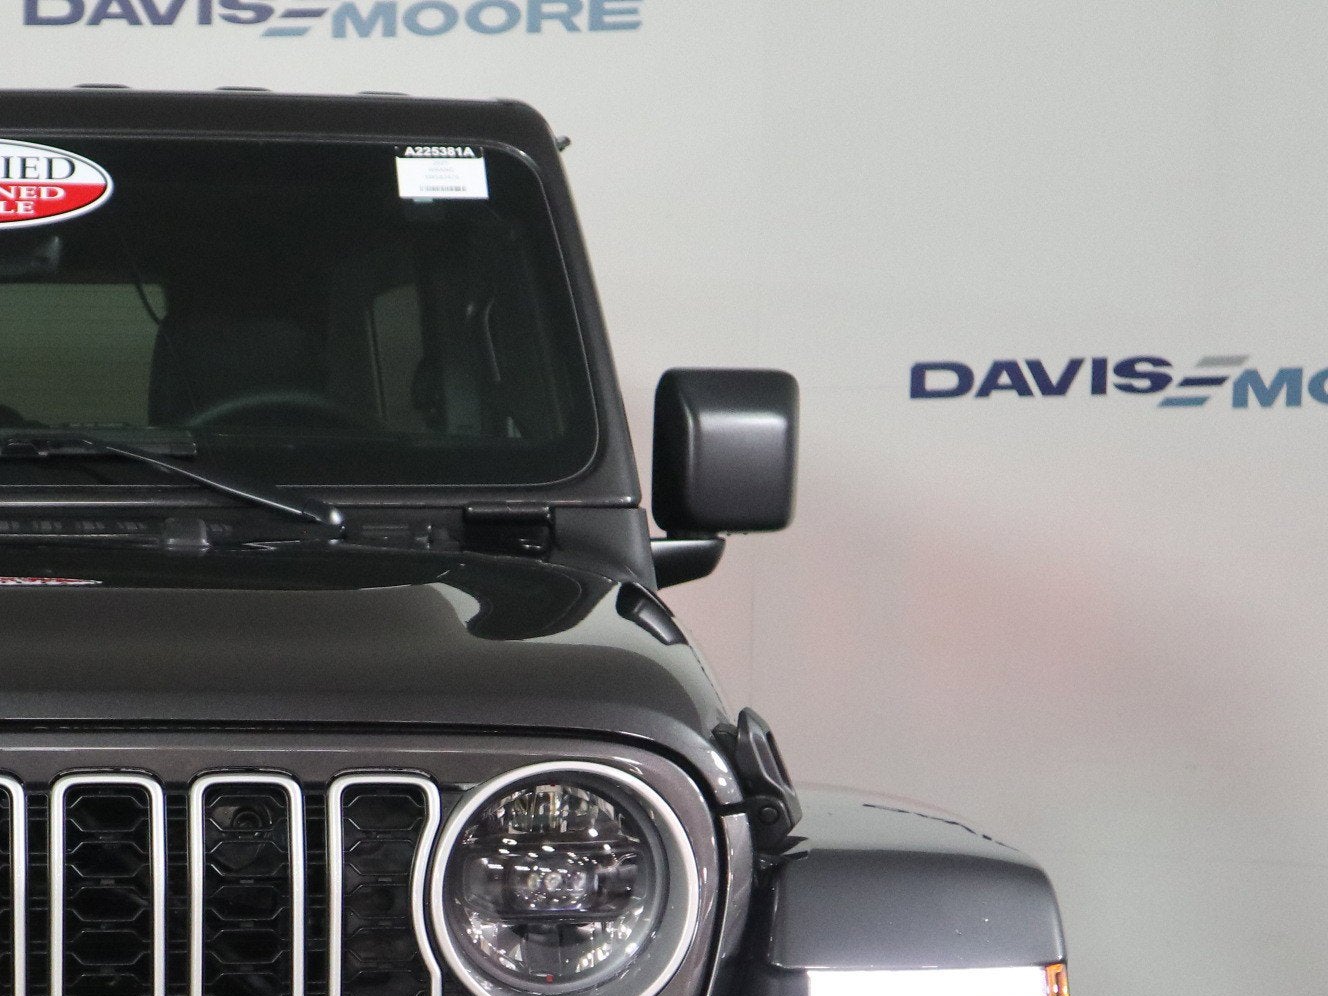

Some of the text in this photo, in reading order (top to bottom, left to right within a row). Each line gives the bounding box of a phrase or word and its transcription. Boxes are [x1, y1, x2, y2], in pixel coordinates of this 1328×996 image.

[23, 0, 642, 38] DAVIS MOORE
[910, 355, 1173, 398] DAVIS
